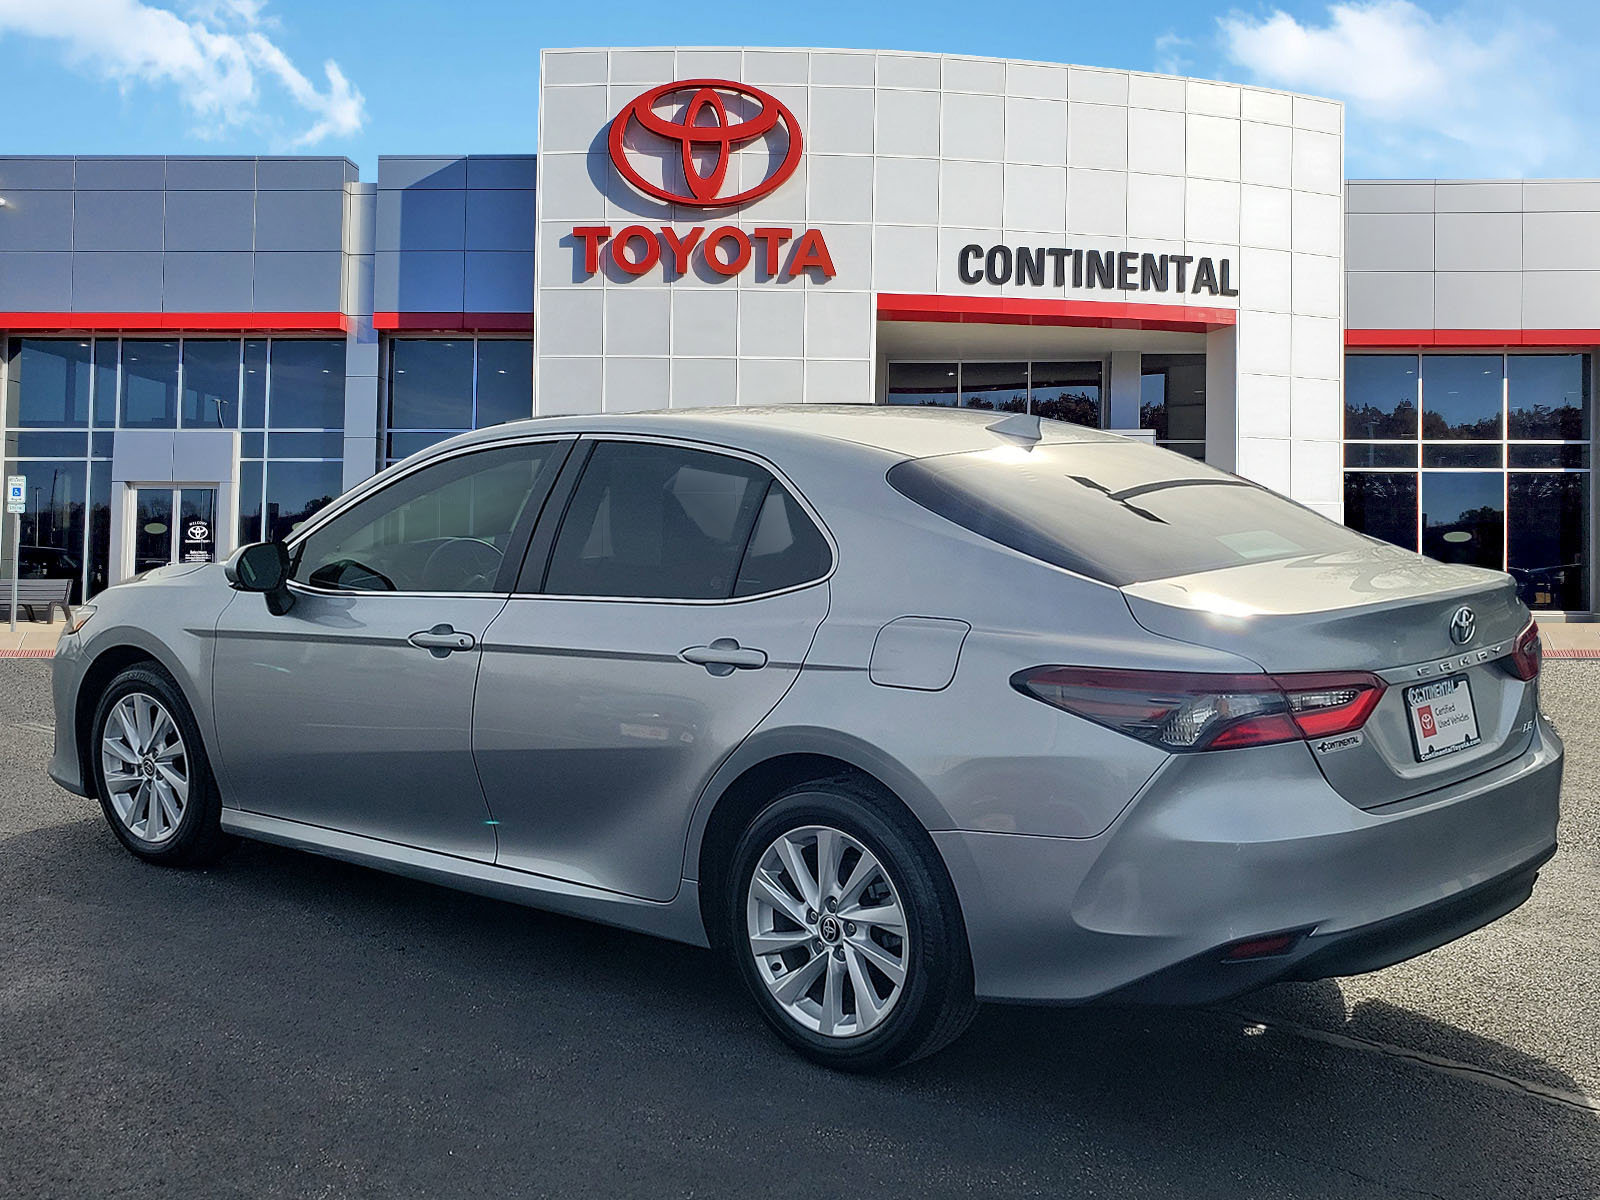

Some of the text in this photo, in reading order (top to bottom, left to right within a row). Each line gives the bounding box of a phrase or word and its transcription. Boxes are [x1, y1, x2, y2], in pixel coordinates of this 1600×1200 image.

[572, 226, 836, 278] TOYOTA
[958, 244, 1239, 297] CONTINENTAL
[1434, 703, 1456, 716] Certified
[1438, 713, 1470, 729] Used Vehicles
